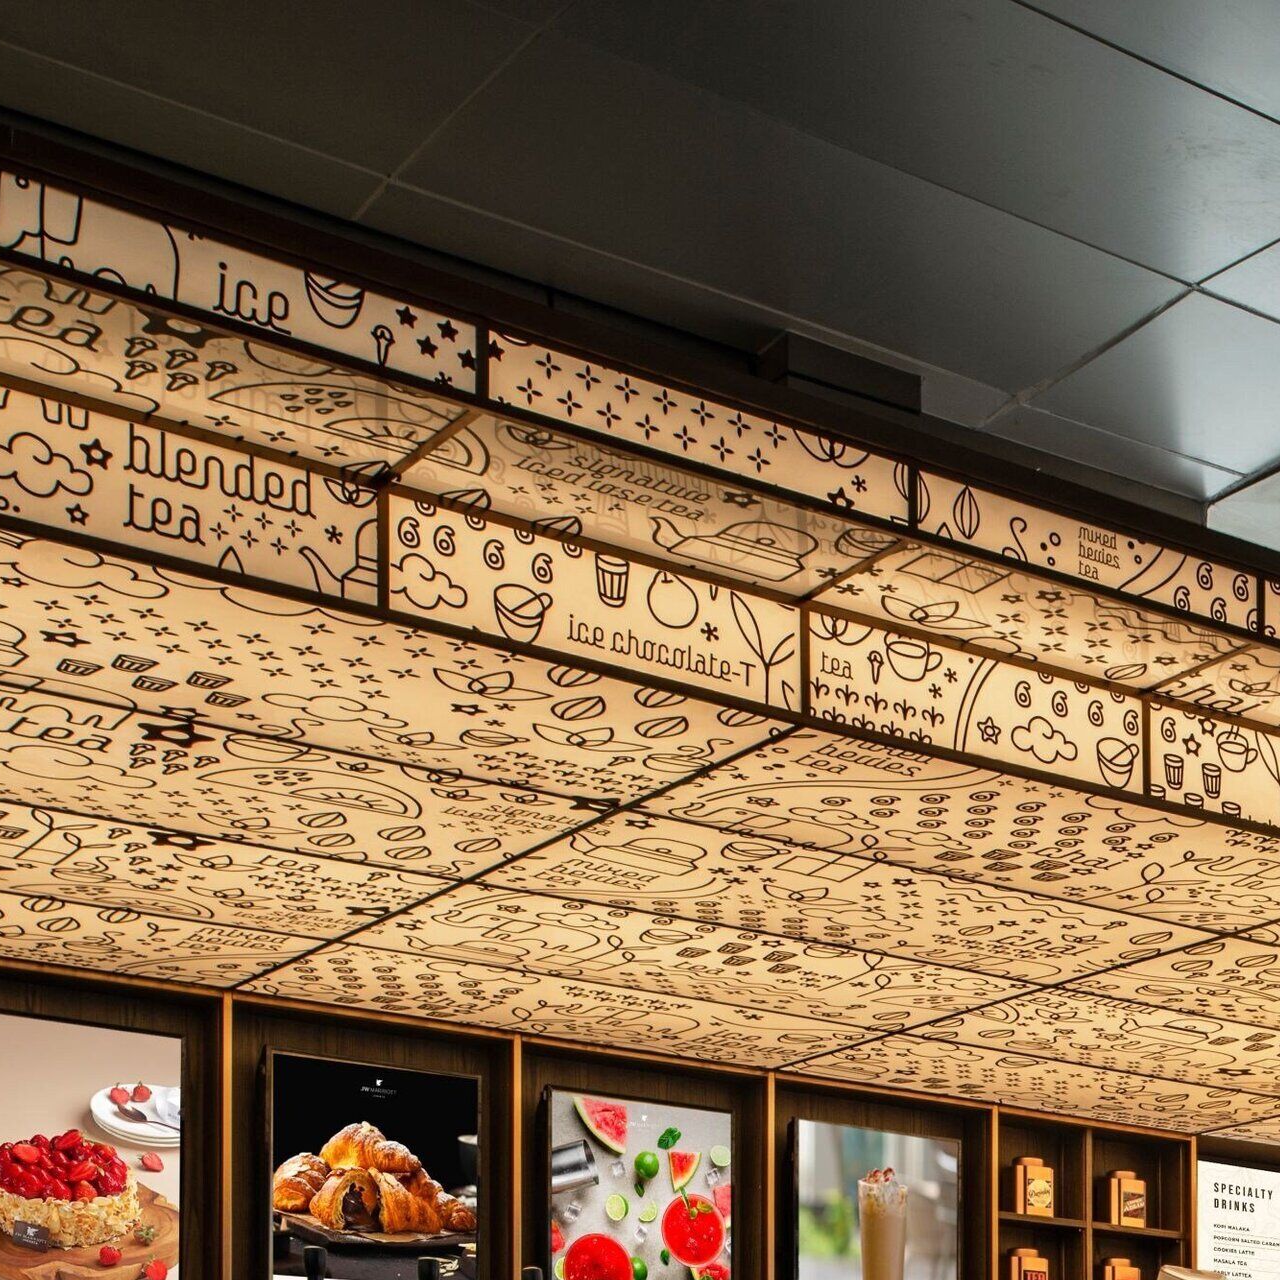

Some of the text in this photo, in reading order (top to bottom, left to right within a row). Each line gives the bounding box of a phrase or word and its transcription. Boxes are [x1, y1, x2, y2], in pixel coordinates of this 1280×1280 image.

[212, 262, 292, 335] ice
[123, 422, 316, 519] blended
[123, 483, 206, 547] tea
[1078, 560, 1100, 581] tea
[566, 613, 605, 650] ice
[820, 650, 854, 680] tea
[1213, 1182, 1274, 1200] SPECIALTY
[1213, 1198, 1256, 1213] DRINKS
